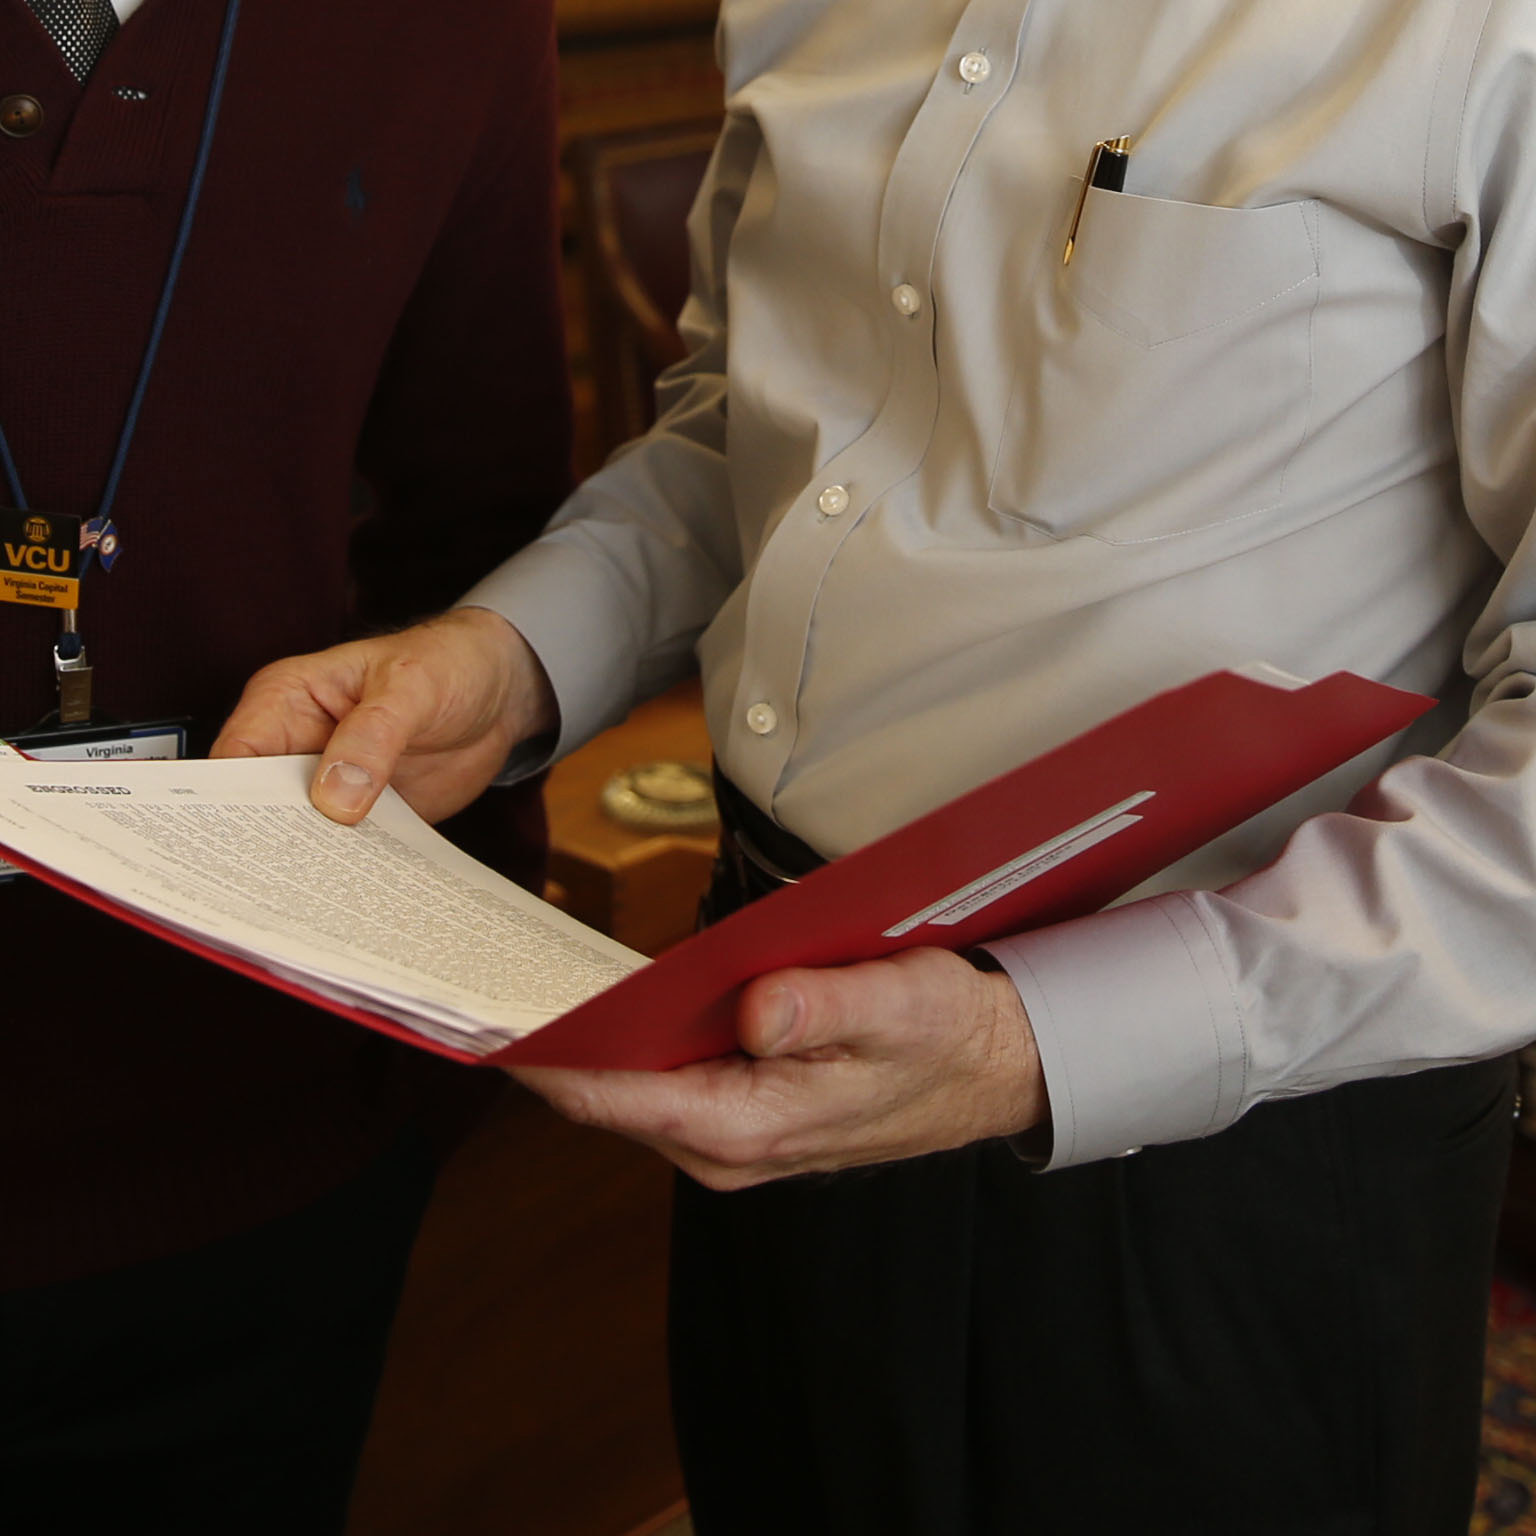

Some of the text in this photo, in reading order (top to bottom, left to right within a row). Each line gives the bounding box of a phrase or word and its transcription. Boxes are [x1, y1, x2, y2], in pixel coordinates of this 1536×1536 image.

[5, 543, 70, 572] VCU
[4, 577, 37, 589] Virginia
[86, 744, 134, 758] Virginia
[25, 784, 131, 795] ENGROSSED
